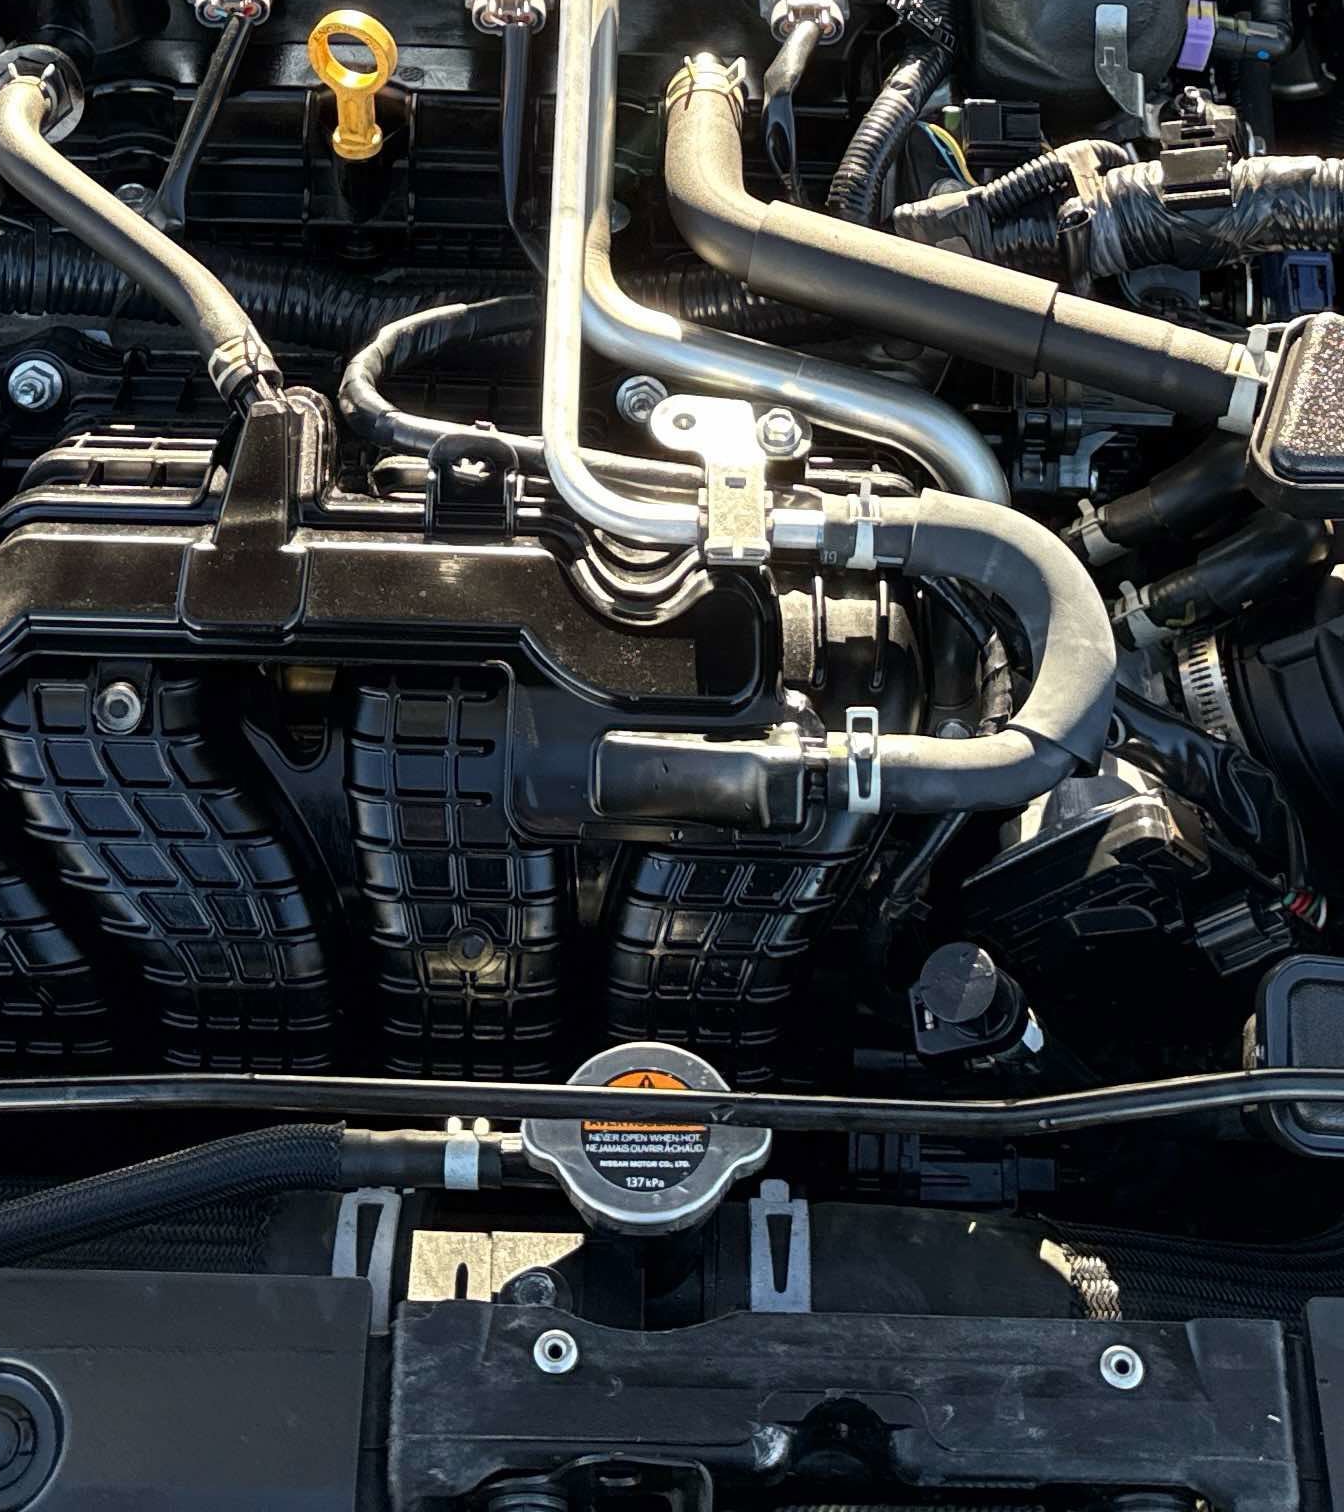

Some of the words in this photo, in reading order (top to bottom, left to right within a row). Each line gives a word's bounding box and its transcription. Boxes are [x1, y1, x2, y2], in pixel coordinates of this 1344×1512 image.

[588, 1133, 619, 1142] NEVER
[621, 1133, 648, 1142] OPEN
[650, 1133, 677, 1142] WHEN
[599, 1160, 629, 1168] NISSAN
[630, 1160, 657, 1168] MOTOR
[625, 1177, 645, 1188] 137
[646, 1177, 665, 1188] kPa
